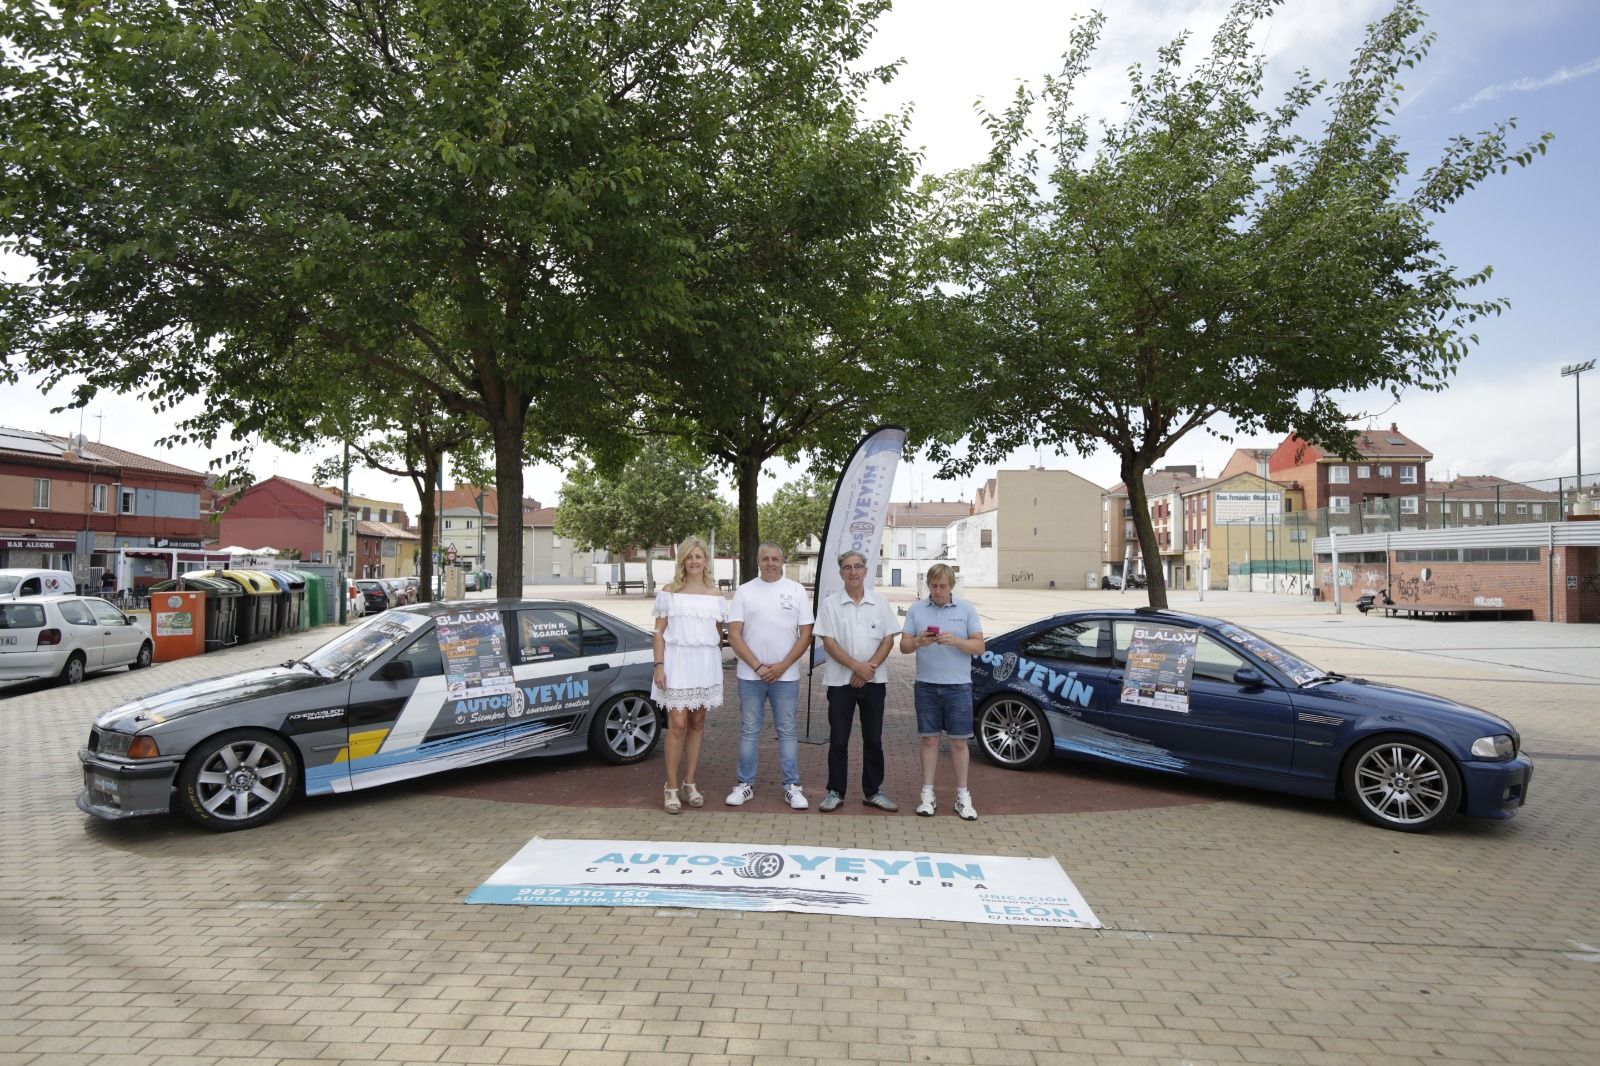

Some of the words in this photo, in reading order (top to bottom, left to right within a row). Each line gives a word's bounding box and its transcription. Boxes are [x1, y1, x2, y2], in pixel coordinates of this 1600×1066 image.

[853, 464, 880, 523] YEYÍN
[436, 611, 501, 626] SLALOM
[1134, 628, 1197, 643] SLALOM
[524, 675, 589, 705] YEYÍN
[1017, 657, 1094, 708] YEYÍN
[455, 694, 512, 715] AUTOS
[470, 711, 507, 723] Siempre
[526, 703, 563, 715] sonriendo
[564, 698, 591, 710] contigo
[591, 852, 747, 868] AUTOS
[787, 854, 986, 881] YEYÍN
[585, 867, 724, 876] CHAPA
[789, 873, 988, 890] PINTURA
[518, 888, 561, 896] 987
[567, 889, 605, 897] 910
[614, 890, 650, 898] 150
[979, 893, 1069, 903] UBICACIÓN
[983, 904, 1079, 919] LEÓN
